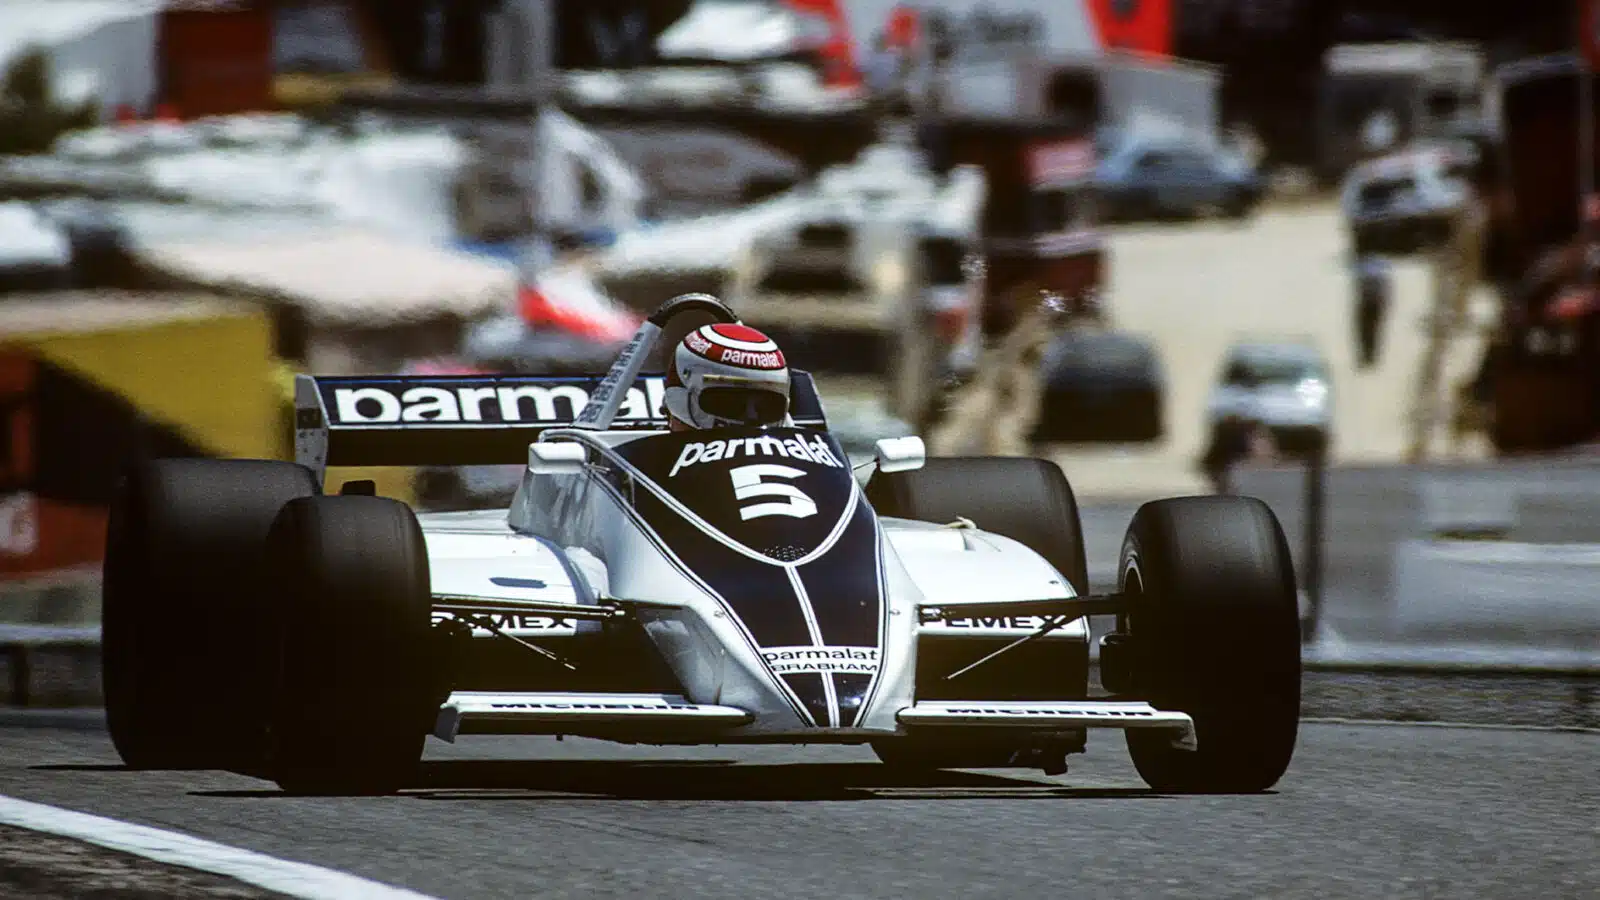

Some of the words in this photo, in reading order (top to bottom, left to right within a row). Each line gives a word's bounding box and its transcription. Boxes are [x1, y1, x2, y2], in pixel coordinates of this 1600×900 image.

[721, 349, 781, 367] parmalat
[334, 377, 668, 422] parmal
[668, 433, 844, 477] parmalat
[729, 464, 818, 521] 5
[431, 612, 574, 630] MEX
[762, 648, 878, 665] parmalat
[771, 663, 878, 672] BRABHAM
